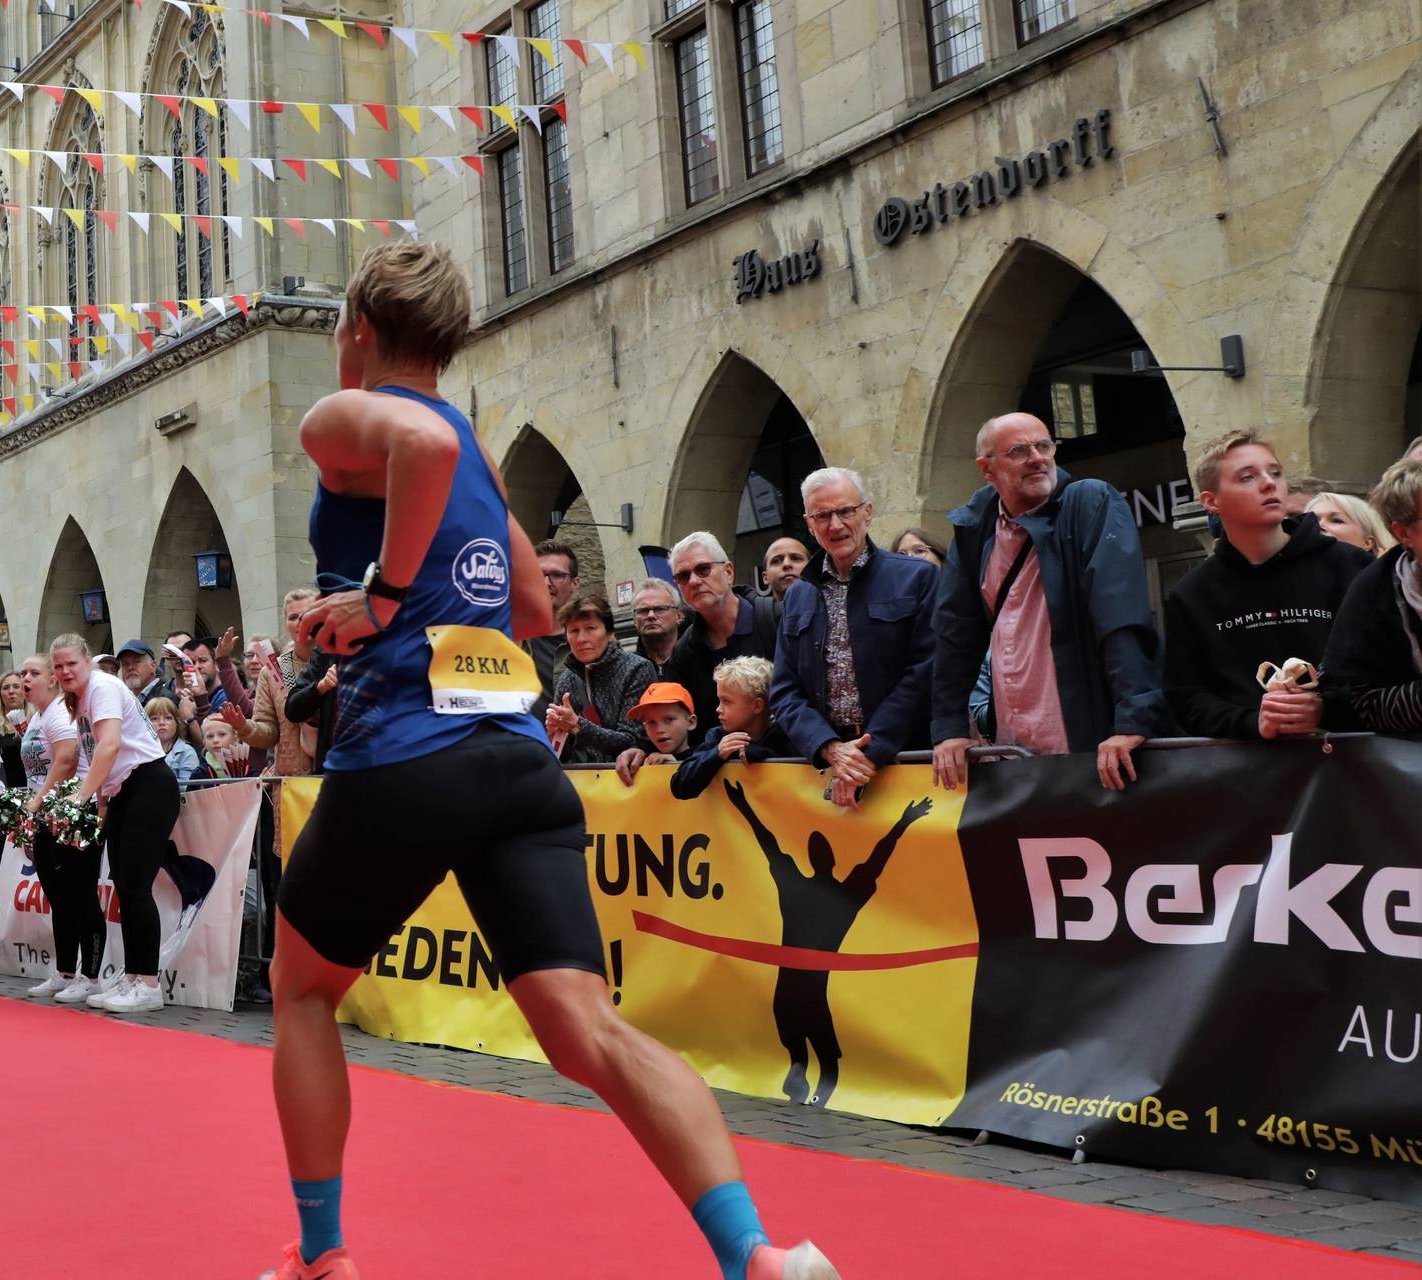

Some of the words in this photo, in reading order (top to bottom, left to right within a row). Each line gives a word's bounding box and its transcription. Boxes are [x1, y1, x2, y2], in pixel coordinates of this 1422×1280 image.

[733, 238, 821, 303] Haus
[874, 108, 1115, 248] Ostendorff
[1216, 611, 1262, 631] TOMMY
[1280, 608, 1332, 619] HILFIGER
[455, 655, 476, 672] 28
[479, 656, 511, 675] KM
[13, 942, 51, 965] The
[999, 1082, 1189, 1130] Rösnerstraße
[1204, 1106, 1219, 1134] 1
[1256, 1113, 1361, 1155] 48155
